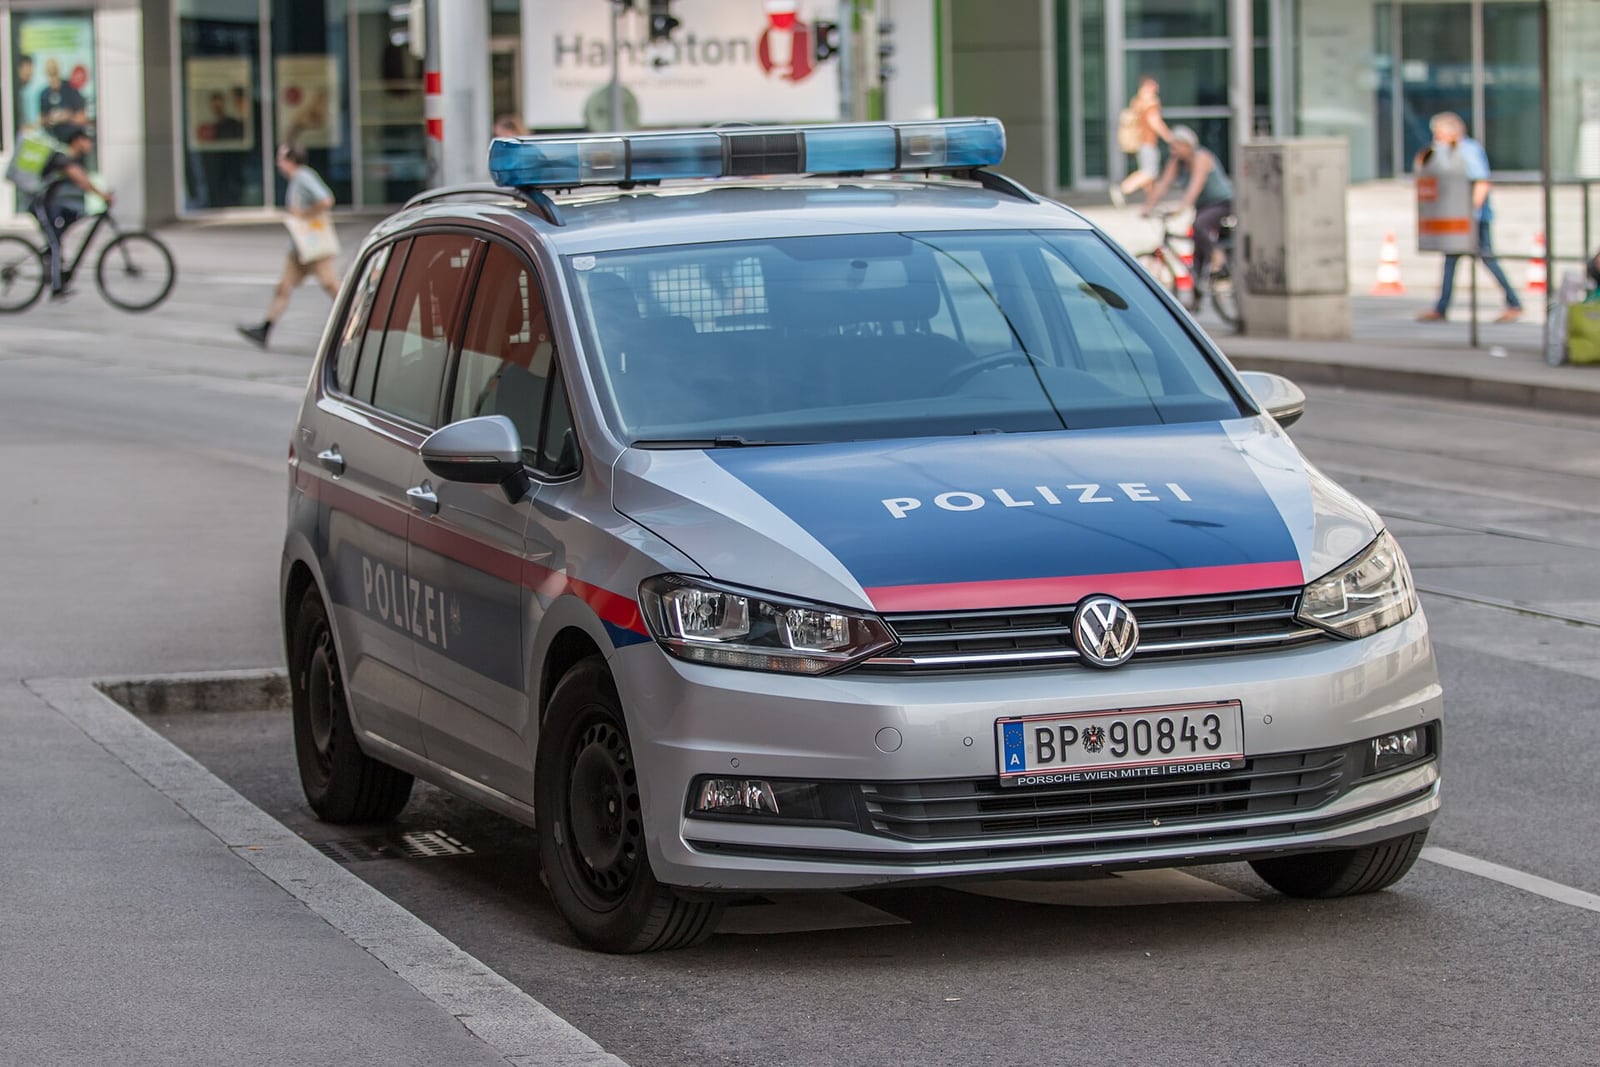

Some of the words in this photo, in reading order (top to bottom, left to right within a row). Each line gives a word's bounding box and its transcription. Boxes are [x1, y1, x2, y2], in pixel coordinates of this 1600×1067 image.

[881, 483, 1192, 519] POLIZEI
[362, 556, 447, 649] POLIZEI
[1035, 725, 1078, 764] BP
[1109, 713, 1222, 757] 90843
[1010, 753, 1020, 766] A
[1017, 773, 1081, 785] PORSCHE
[1084, 770, 1119, 780] WIEN
[1121, 766, 1159, 777] MITTE
[1169, 761, 1231, 774] ERDBERG
